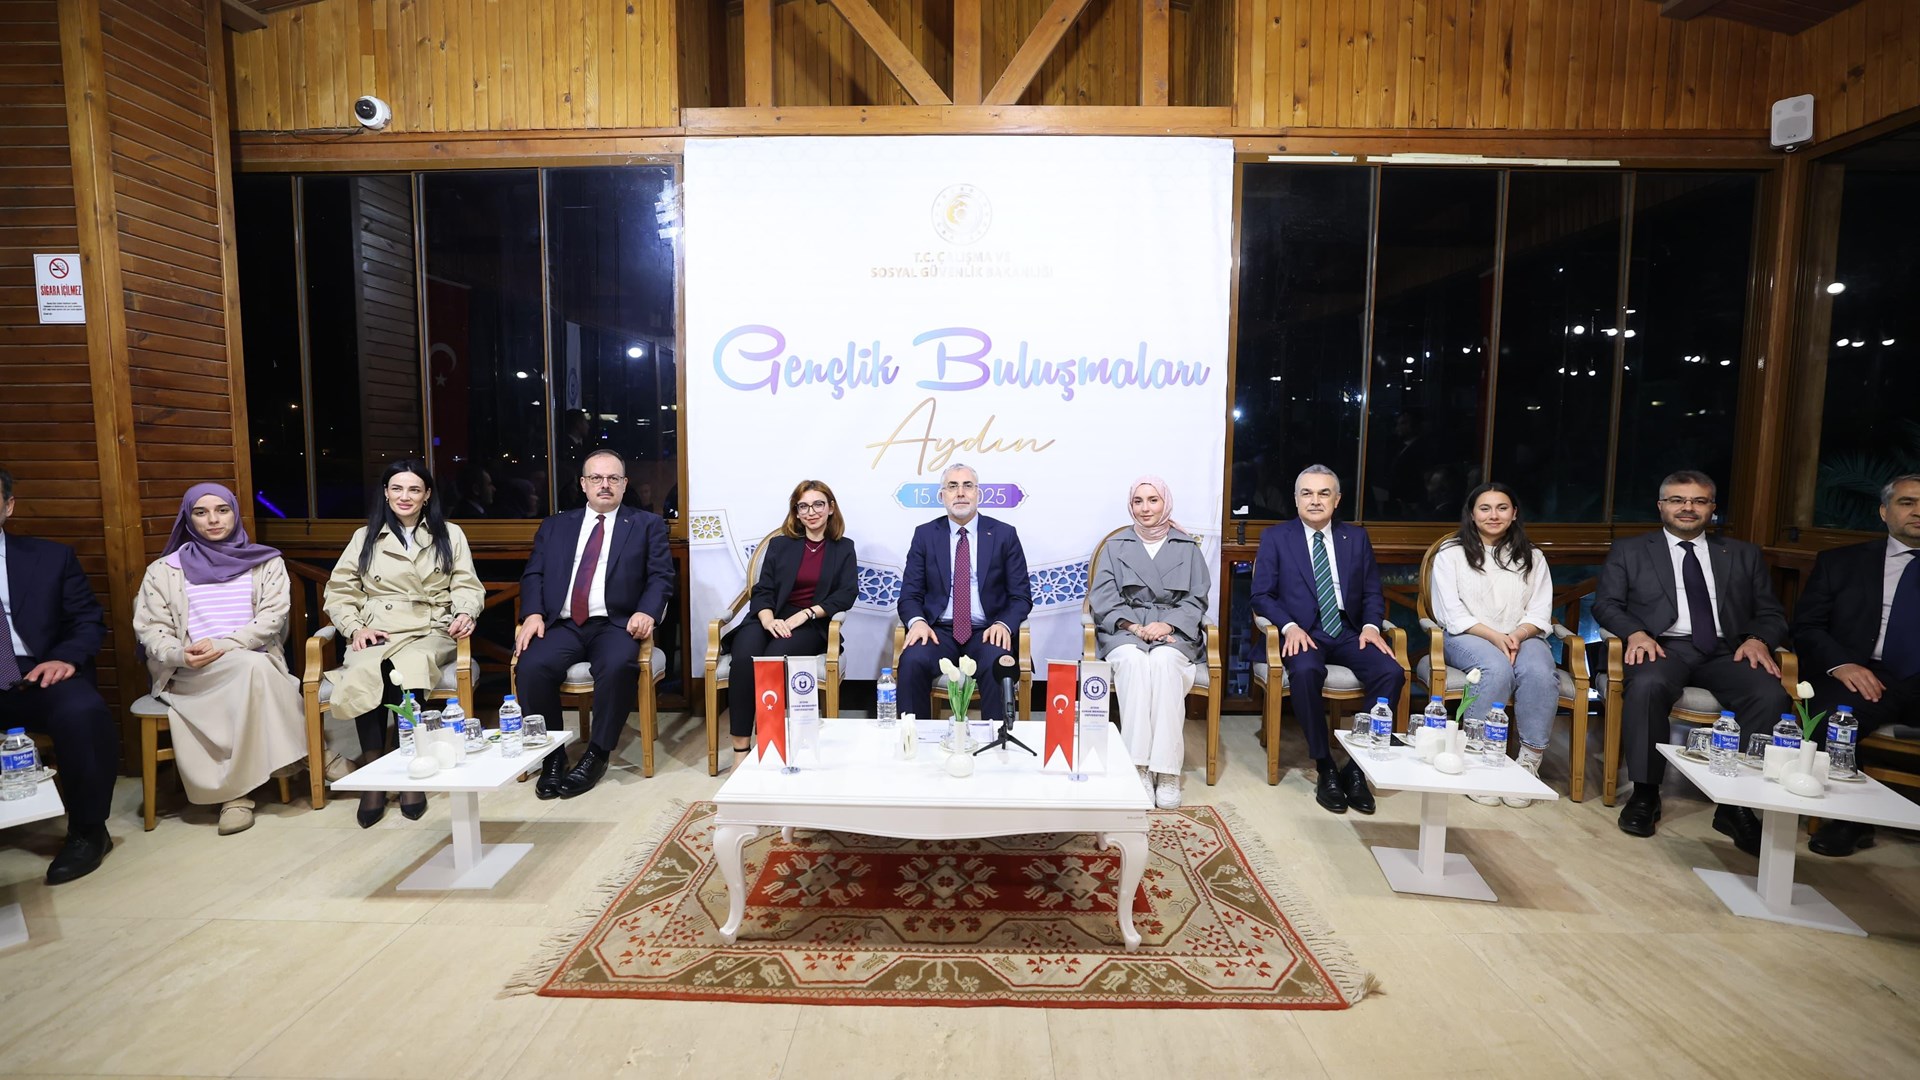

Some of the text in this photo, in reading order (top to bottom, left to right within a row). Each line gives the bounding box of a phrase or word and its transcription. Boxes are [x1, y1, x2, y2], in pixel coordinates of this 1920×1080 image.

[913, 252, 935, 263] T.C.
[870, 267, 917, 278] SOSYAL
[40, 284, 60, 296] SİGARA
[712, 324, 1210, 402] Gençlik Buluşmaları
[865, 397, 1056, 475] Aydın
